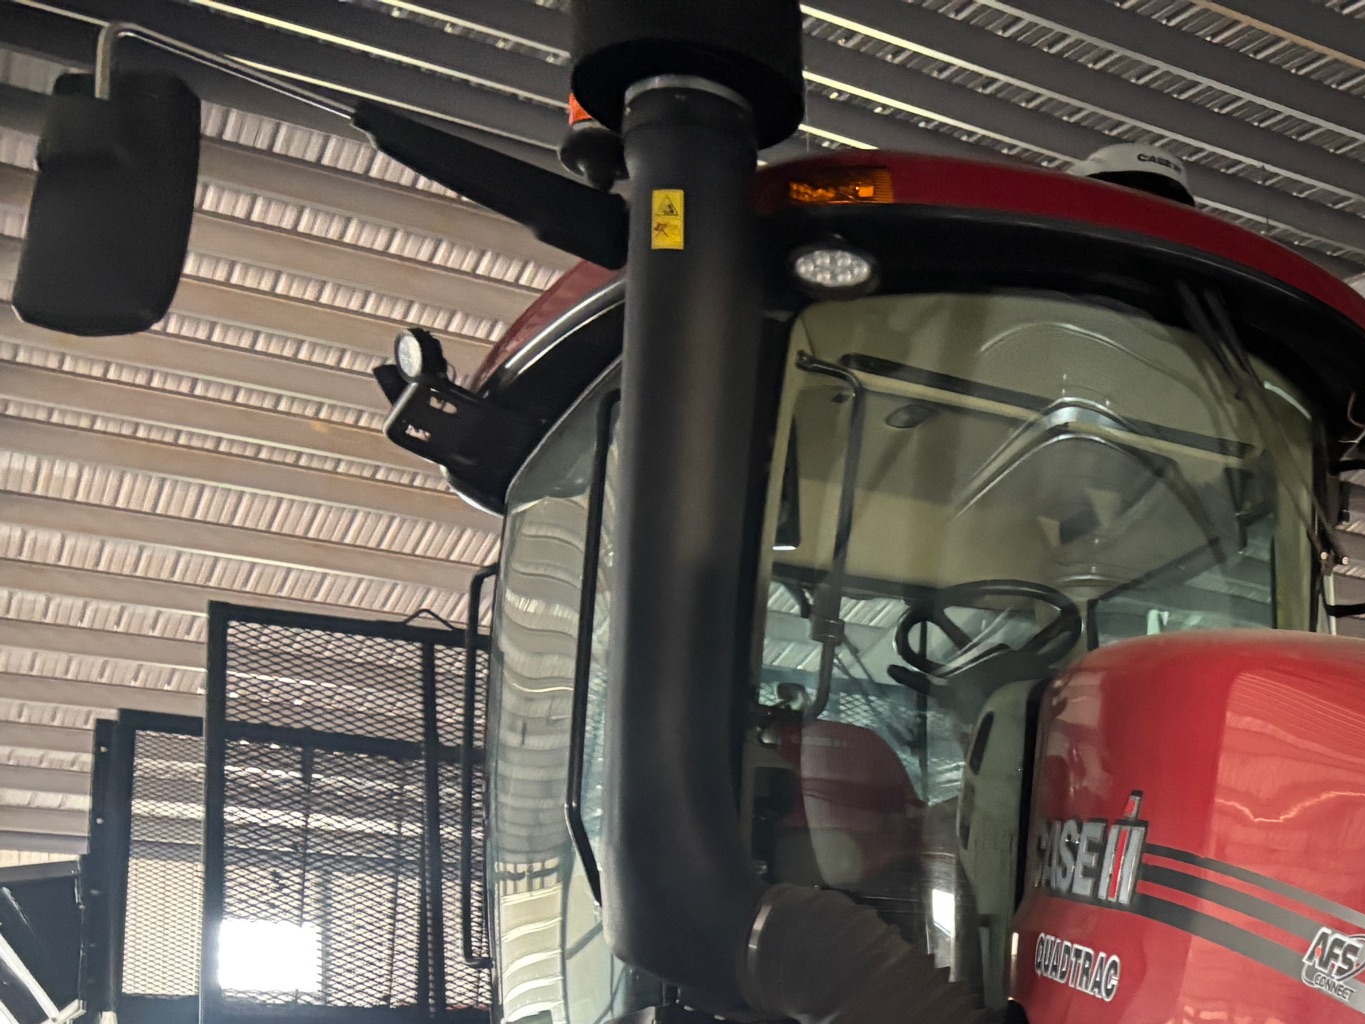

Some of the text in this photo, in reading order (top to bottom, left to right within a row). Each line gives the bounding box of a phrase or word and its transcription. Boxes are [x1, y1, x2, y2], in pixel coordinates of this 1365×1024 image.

[1034, 932, 1121, 1002] QUADTRAC
[1302, 927, 1364, 980] AFS
[1314, 972, 1356, 1002] CONNECT
